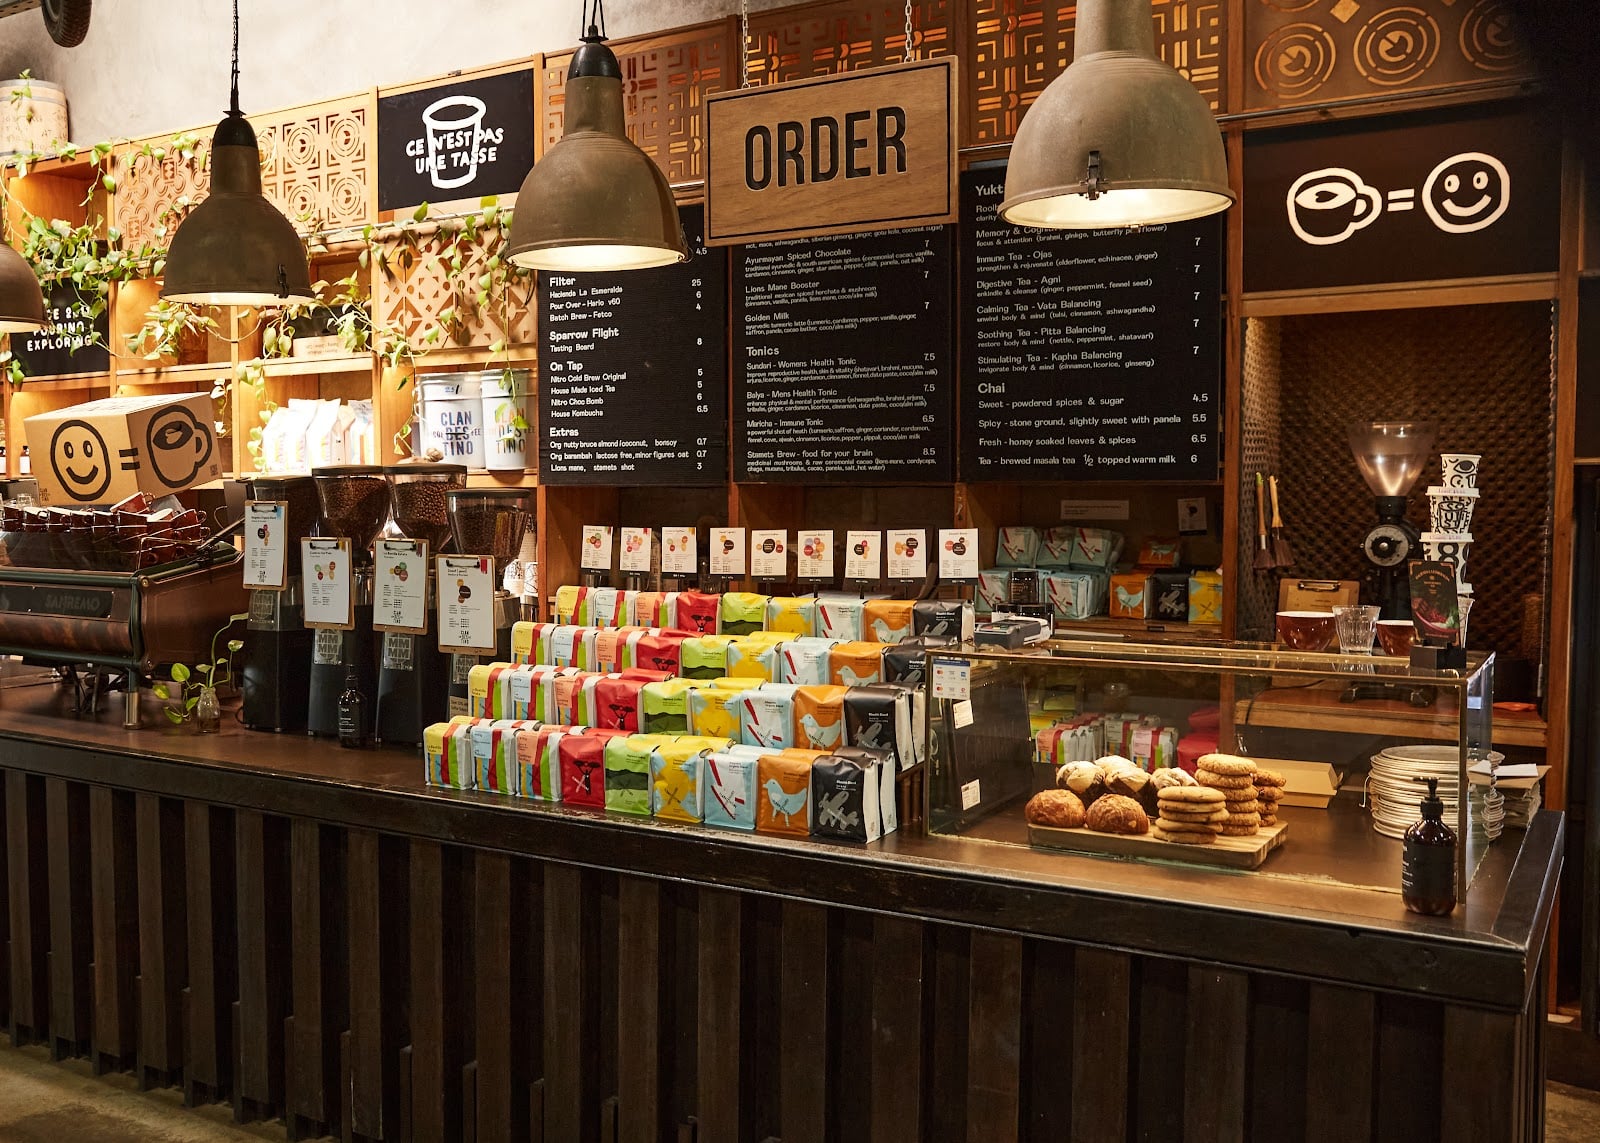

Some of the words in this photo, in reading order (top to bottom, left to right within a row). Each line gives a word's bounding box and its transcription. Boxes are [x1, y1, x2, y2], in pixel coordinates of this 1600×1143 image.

[406, 139, 424, 156] CE
[476, 127, 504, 144] PAS
[745, 106, 907, 190] ORDER
[416, 155, 446, 174] UNE
[451, 147, 497, 168] TASSE
[976, 230, 1010, 238] Memory
[1013, 227, 1020, 235] &
[925, 239, 929, 248] 7
[1195, 237, 1200, 246] 7
[696, 247, 707, 255] 4.5
[787, 251, 811, 262] Spiced
[815, 248, 851, 258] Chocolate
[977, 256, 1004, 264] Immune
[1008, 252, 1022, 261] Tea
[1033, 250, 1052, 260] Ojas
[1194, 264, 1200, 273] 7
[924, 270, 928, 278] 7
[550, 276, 576, 287] Filter
[692, 278, 701, 287] 25
[768, 283, 787, 291] Mane
[791, 281, 819, 290] Booster
[977, 280, 1012, 290] Digestive
[1017, 277, 1031, 286] Tea
[1041, 275, 1060, 286] Agni
[696, 290, 701, 298] 6
[1194, 292, 1200, 300] 7
[550, 302, 564, 310] Pour
[566, 301, 581, 309] Over
[608, 297, 620, 305] v60
[925, 301, 929, 310] 7
[977, 305, 1008, 314] Calming
[1014, 303, 1028, 311] Tea
[1037, 302, 1057, 310] Vata
[1061, 299, 1101, 309] Balancing
[550, 313, 568, 322] Batch
[571, 312, 587, 320] Brew
[745, 314, 770, 322] Golden
[774, 312, 789, 320] Milk
[1194, 319, 1199, 327] 7
[550, 331, 588, 342] Sparrow
[593, 327, 619, 340] Flight
[978, 330, 1012, 339] Soothing
[1017, 328, 1030, 337] Tea
[1041, 327, 1061, 336] Pitta
[1066, 325, 1105, 334] Balancing
[576, 343, 594, 351] Board
[697, 338, 702, 346] 8
[746, 346, 779, 357] Tonics
[1193, 346, 1199, 355] 7
[924, 353, 935, 361] 7.5
[978, 355, 1021, 364] Stimulating
[1026, 354, 1040, 362] Tea
[1052, 352, 1077, 362] Kapha
[1081, 350, 1122, 360] Balancing
[550, 362, 563, 372] On
[778, 360, 807, 368] Womens
[811, 358, 834, 366] Health
[568, 374, 582, 382] Cold
[584, 374, 600, 382] Brew
[603, 372, 626, 382] Original
[698, 368, 703, 376] 5
[698, 380, 702, 388] 5
[924, 384, 935, 392] 7.5
[978, 382, 1005, 394] Chai
[551, 387, 569, 395] House
[571, 386, 587, 394] Made
[589, 385, 603, 393] Iced
[772, 390, 791, 398] Mens
[793, 389, 816, 397] Health
[818, 388, 837, 396] Tonic
[569, 398, 585, 406] Choc
[586, 397, 603, 405] Bomb
[1193, 393, 1208, 402] 4.5
[979, 400, 1003, 409] Sweet
[1012, 398, 1052, 409] powdered
[1056, 398, 1082, 408] spices
[1088, 397, 1095, 405] &
[1100, 398, 1124, 406] sugar
[551, 410, 570, 418] House
[572, 409, 603, 417] Kombucha
[697, 405, 708, 413] 6.5
[440, 411, 472, 426] CLAN
[780, 419, 804, 427] Immune
[806, 418, 823, 426] Tonic
[922, 414, 934, 422] 6.5
[979, 419, 1001, 429] Spicy
[1010, 419, 1032, 427] stone
[1034, 417, 1065, 428] ground,
[1069, 416, 1099, 427] slightly
[1131, 415, 1150, 424] with
[1154, 414, 1181, 425] panela
[1193, 413, 1206, 422] 5.5
[550, 427, 579, 437] Extras
[979, 438, 1001, 446] Fresh
[1009, 438, 1033, 447] honey
[1036, 437, 1064, 445] soaked
[1068, 436, 1094, 445] leaves
[1099, 436, 1106, 444] &
[1109, 436, 1136, 446] spices
[1191, 434, 1206, 443] 6.5
[442, 440, 473, 456] TINO
[923, 447, 935, 455] 8.5
[777, 450, 796, 458] Brew
[802, 450, 818, 458] food
[854, 449, 873, 457] brain
[1191, 454, 1197, 463] 6
[978, 457, 991, 465] Tea
[1001, 456, 1031, 465] brewed
[1034, 456, 1059, 464] masala
[1098, 455, 1130, 466] topped
[1159, 455, 1176, 463] milk
[45, 595, 100, 611] SANREMO
